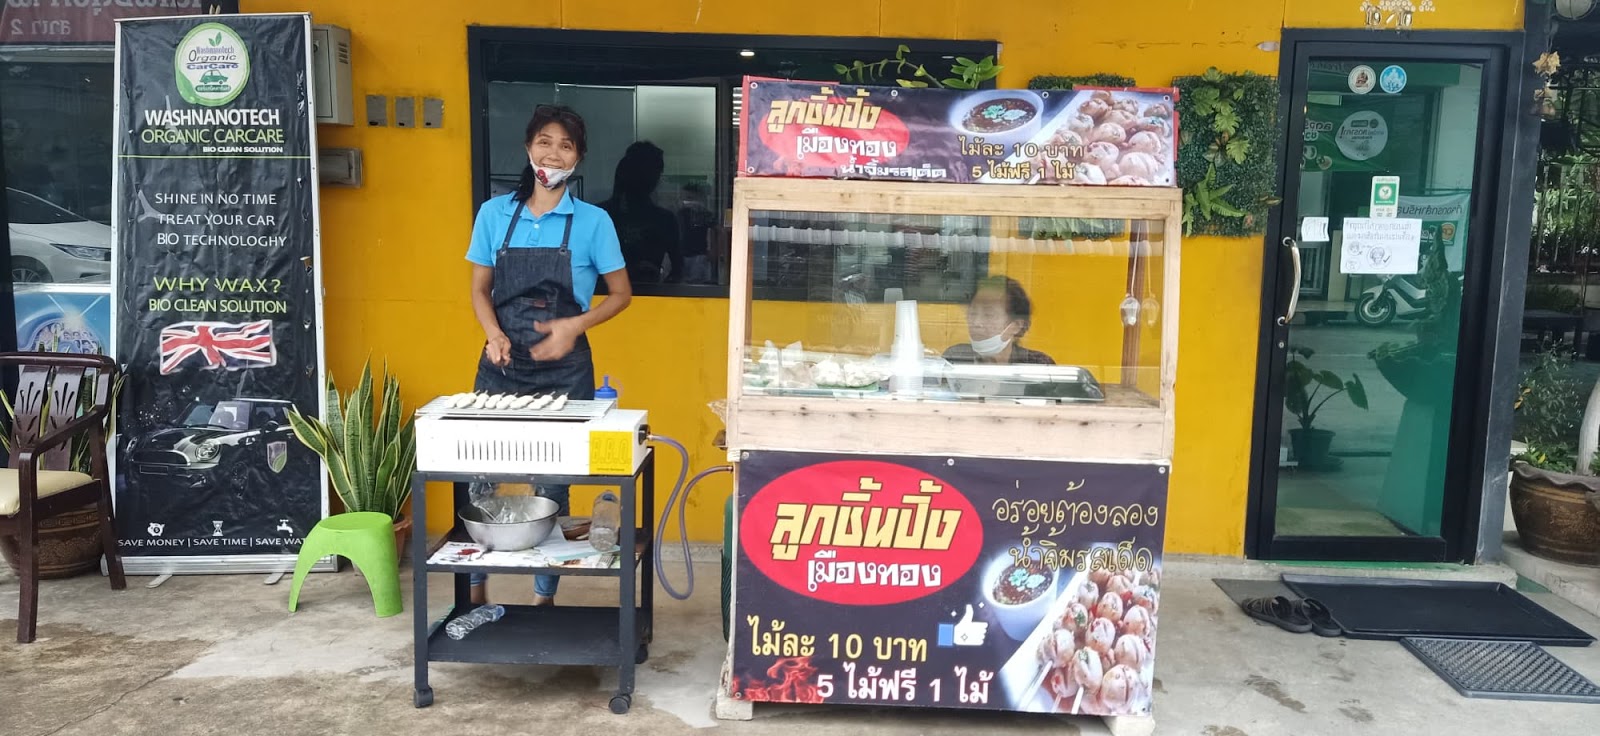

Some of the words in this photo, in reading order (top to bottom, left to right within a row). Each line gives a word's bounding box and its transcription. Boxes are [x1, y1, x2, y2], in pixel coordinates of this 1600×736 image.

[188, 50, 237, 63] Organic
[144, 109, 280, 126] WASHNANOTECH
[767, 86, 881, 133] ลูกชิ้นปิ้ง
[141, 129, 211, 144] ORGANIC
[213, 128, 285, 144] CARCARE
[797, 128, 897, 160] เมืองทอง
[958, 136, 1004, 158] ไม้ละ
[1013, 143, 1039, 158] 10
[1046, 143, 1084, 159] บาท
[840, 156, 947, 181] น้ำจิ้มรสเด็ด
[971, 166, 982, 179] 5
[987, 160, 1032, 180] ไม้ฟรี
[1037, 167, 1046, 179] 1
[1052, 160, 1077, 180] ไม้
[155, 193, 198, 205] SHINE
[200, 193, 214, 205] IN
[218, 193, 239, 205] NO
[242, 193, 278, 205] TIME
[158, 214, 202, 225] TREAT
[204, 215, 244, 226] YOUR
[246, 215, 276, 226] CAR
[157, 233, 179, 245] BIO
[182, 234, 288, 247] TECHNOLOGHY
[153, 277, 209, 292] WHY
[214, 278, 281, 293] WAX?
[148, 299, 171, 312] BIO
[174, 299, 217, 312] CLEAN
[219, 299, 287, 313] SOLUTION
[991, 479, 1159, 527] อร่อยต้องลอง
[769, 476, 962, 561] ลูกชิ้นปิ้ง
[118, 539, 144, 547] SAVE
[146, 539, 185, 547] MONEY
[193, 538, 220, 546] SAVE
[222, 538, 248, 546] TIME
[255, 538, 282, 546] SAVE
[283, 537, 306, 546] WAT
[1008, 523, 1153, 572] น้ำจิ้มรสเด็ด
[807, 549, 942, 592] เมืองทอง
[747, 615, 815, 658] ไม้ละ
[827, 633, 863, 660] 10
[873, 635, 928, 662] บาท
[816, 674, 834, 698] 5
[843, 661, 917, 701] ไม้ฟรี
[928, 678, 941, 702] 1
[954, 665, 994, 704] ไม้
